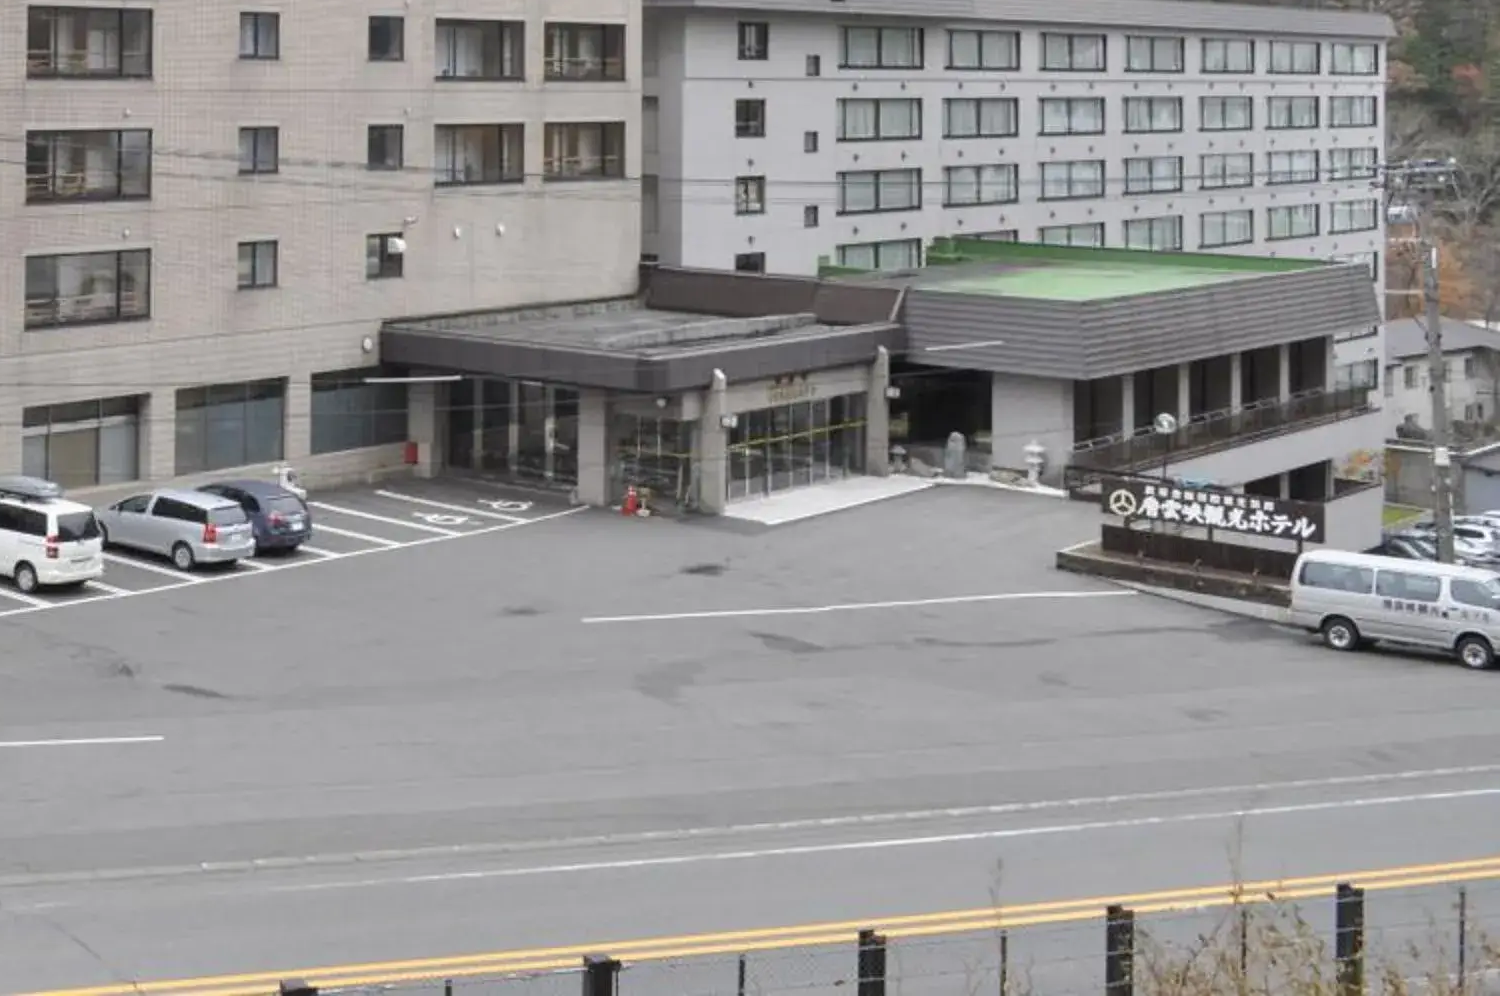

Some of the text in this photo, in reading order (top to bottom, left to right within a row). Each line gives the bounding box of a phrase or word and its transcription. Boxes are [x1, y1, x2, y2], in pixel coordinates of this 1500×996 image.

[1136, 495, 1316, 539] 層雲峡観光ホテル
